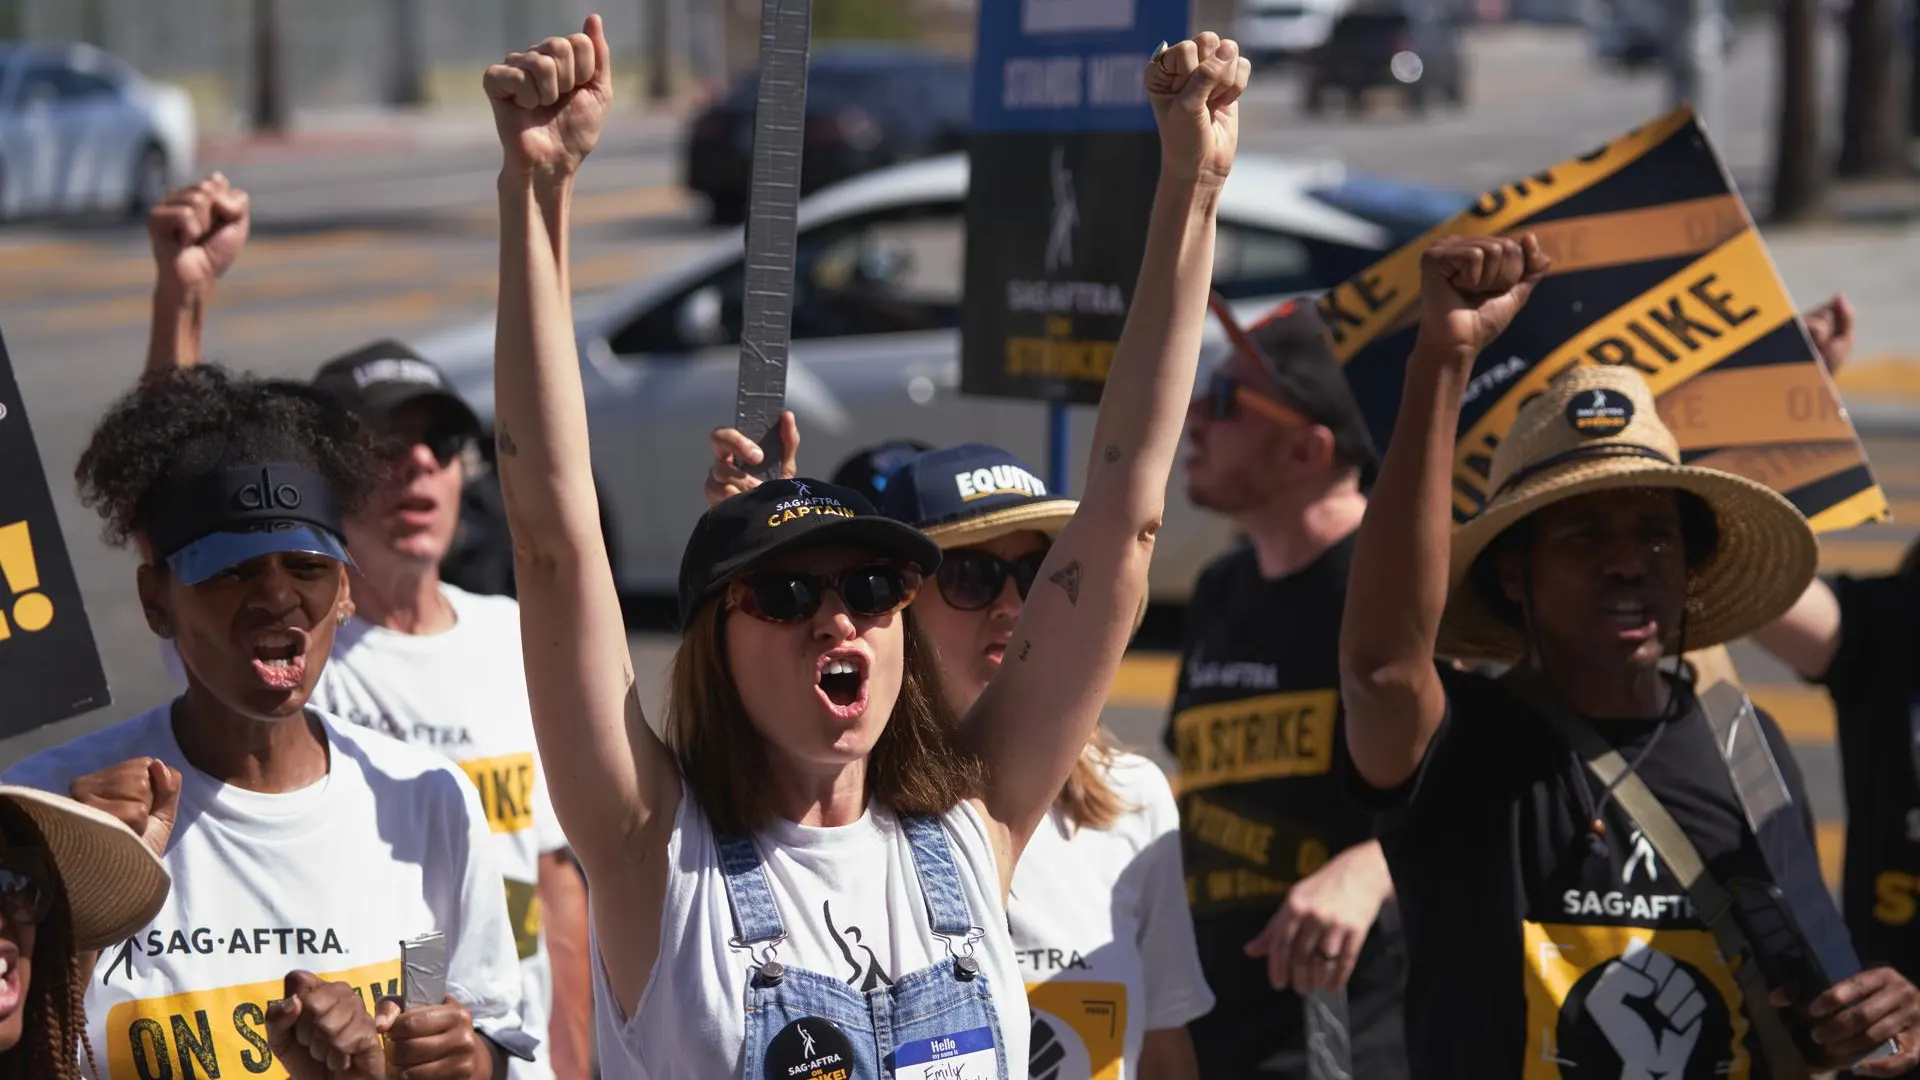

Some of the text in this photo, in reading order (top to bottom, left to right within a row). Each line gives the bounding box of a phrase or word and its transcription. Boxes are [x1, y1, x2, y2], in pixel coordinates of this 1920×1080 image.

[232, 466, 302, 511] alo
[767, 505, 855, 528] CAPTAIN
[930, 1038, 956, 1053] Hello
[811, 1068, 823, 1077] ON
[924, 1062, 965, 1080] Emily
